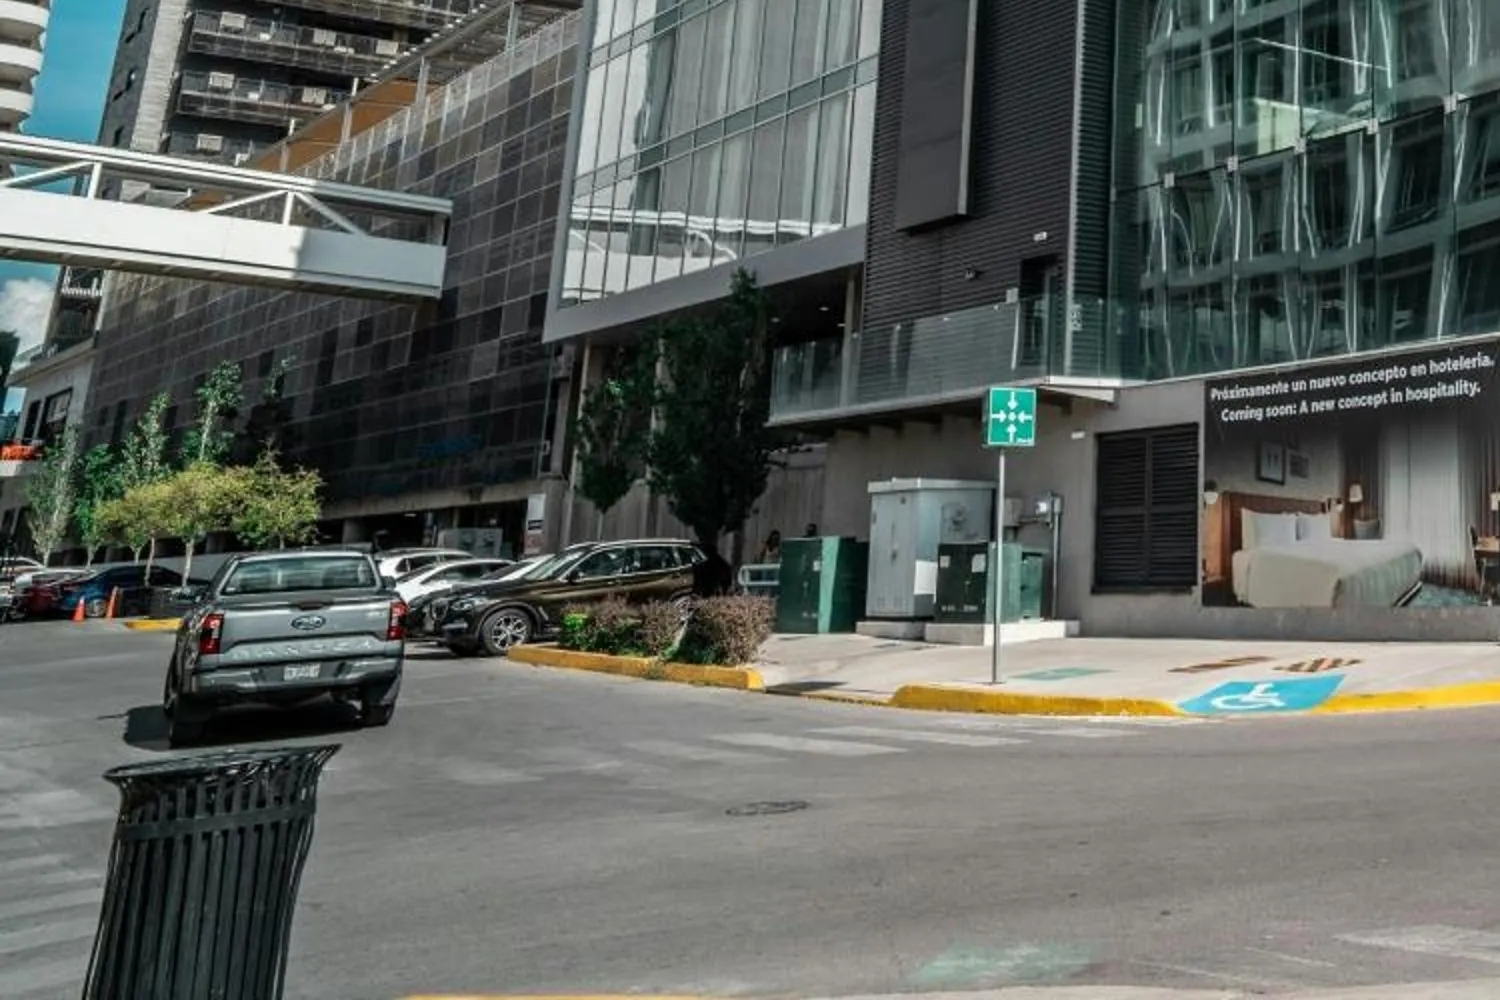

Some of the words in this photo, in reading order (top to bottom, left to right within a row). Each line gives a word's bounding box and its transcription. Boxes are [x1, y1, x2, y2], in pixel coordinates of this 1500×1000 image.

[1292, 380, 1307, 392] un
[1309, 375, 1347, 389] nuevo
[1349, 366, 1407, 384] concepto
[1410, 363, 1427, 377] en
[1221, 405, 1263, 422] Coming
[1265, 403, 1297, 418] soon:
[1300, 400, 1309, 414] A
[1311, 399, 1336, 413] new
[1338, 391, 1388, 409] concept
[1390, 387, 1403, 403] in
[1405, 379, 1481, 403] hospitality.
